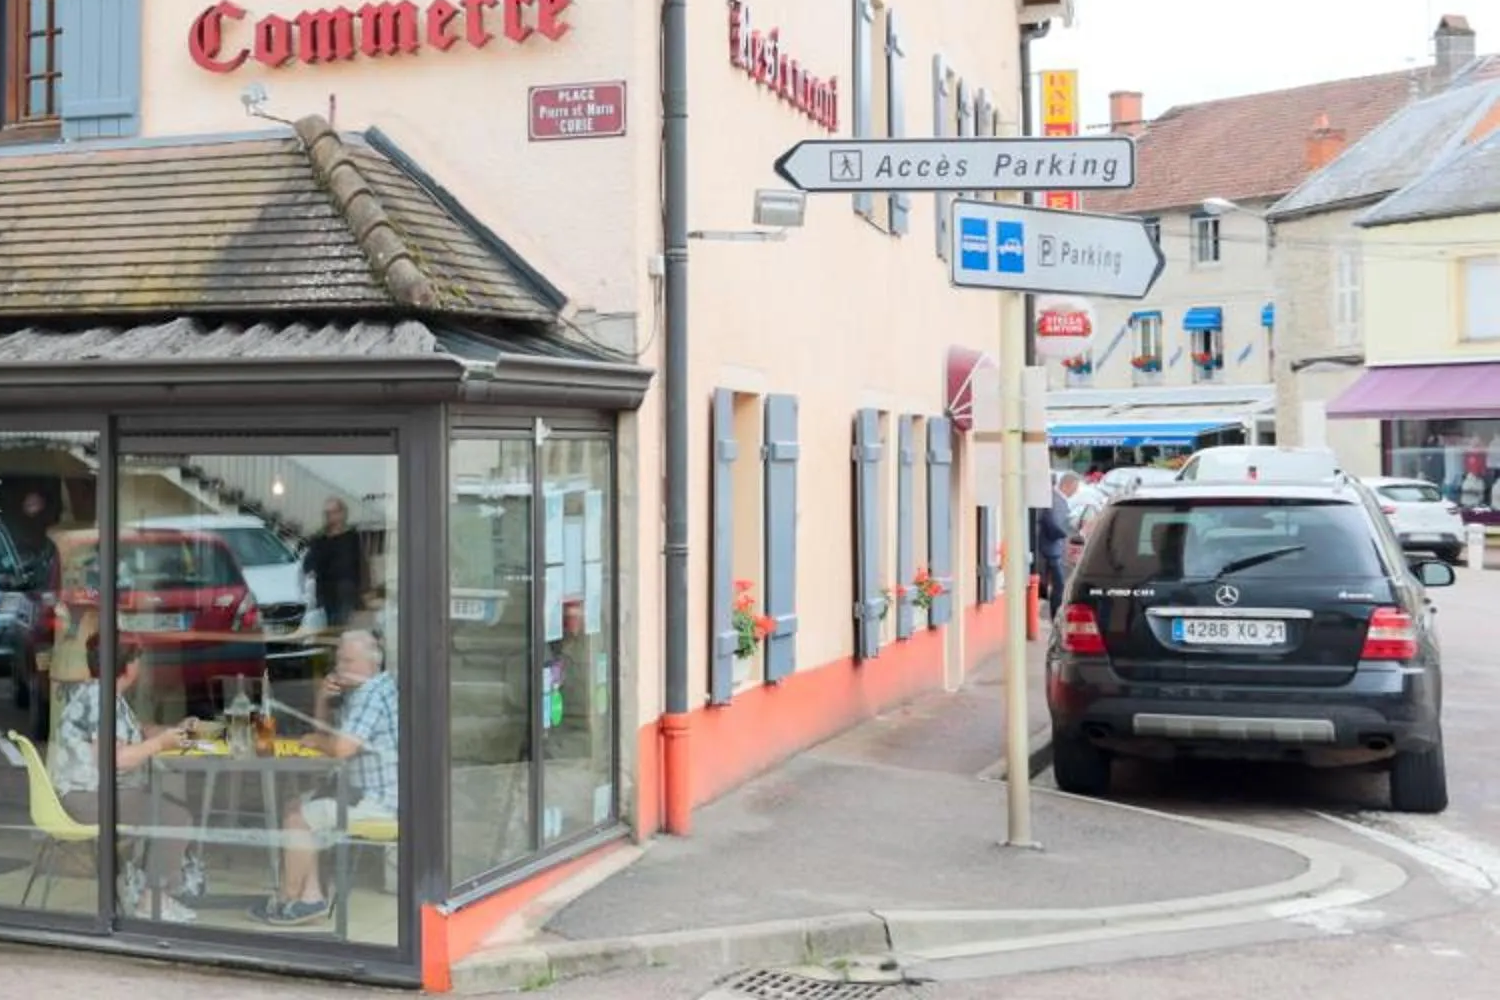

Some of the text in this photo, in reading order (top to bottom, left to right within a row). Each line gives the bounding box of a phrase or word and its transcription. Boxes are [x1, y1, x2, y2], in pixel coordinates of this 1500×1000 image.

[558, 88, 595, 102] PLACE
[875, 153, 1119, 182] Accès Parking
[1060, 240, 1123, 276] Parking
[1187, 621, 1229, 639] 4288
[1266, 622, 1285, 640] 21
